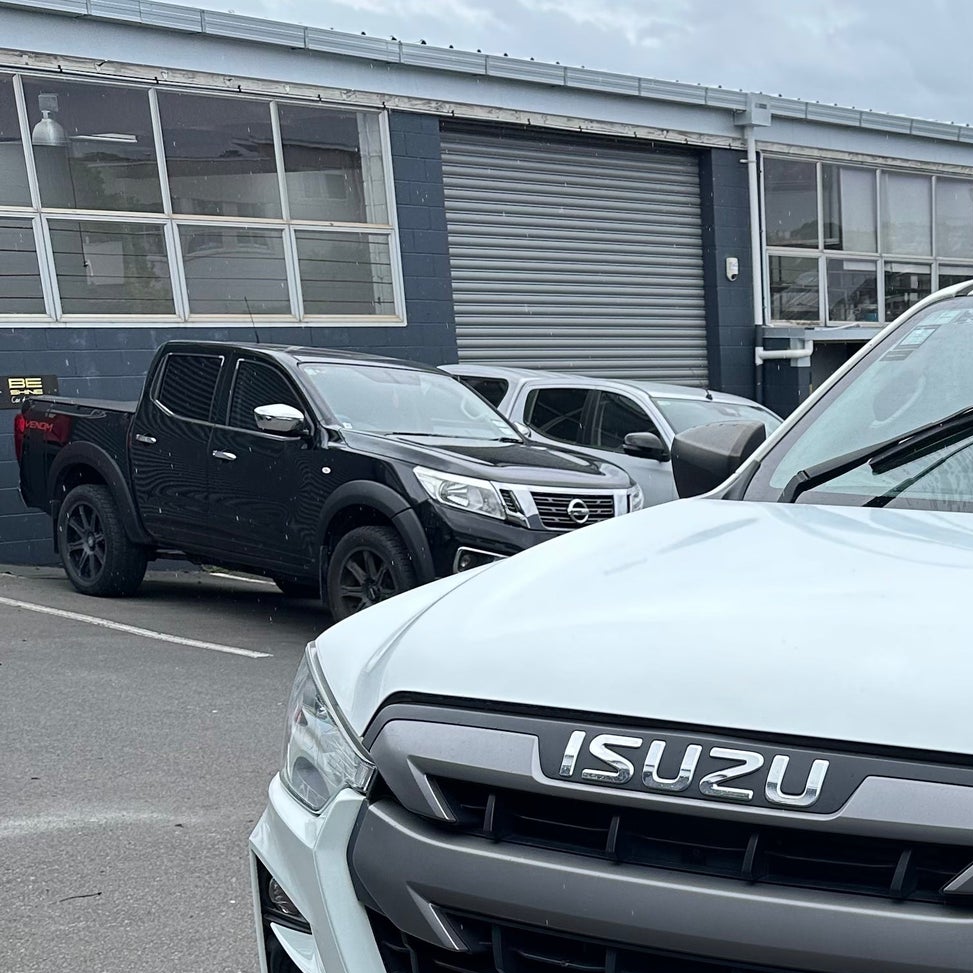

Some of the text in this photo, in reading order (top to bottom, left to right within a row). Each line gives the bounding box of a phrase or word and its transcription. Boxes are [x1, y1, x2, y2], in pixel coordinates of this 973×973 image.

[8, 378, 42, 388] BE
[25, 420, 54, 433] VENOM
[559, 730, 830, 807] ISUZU
